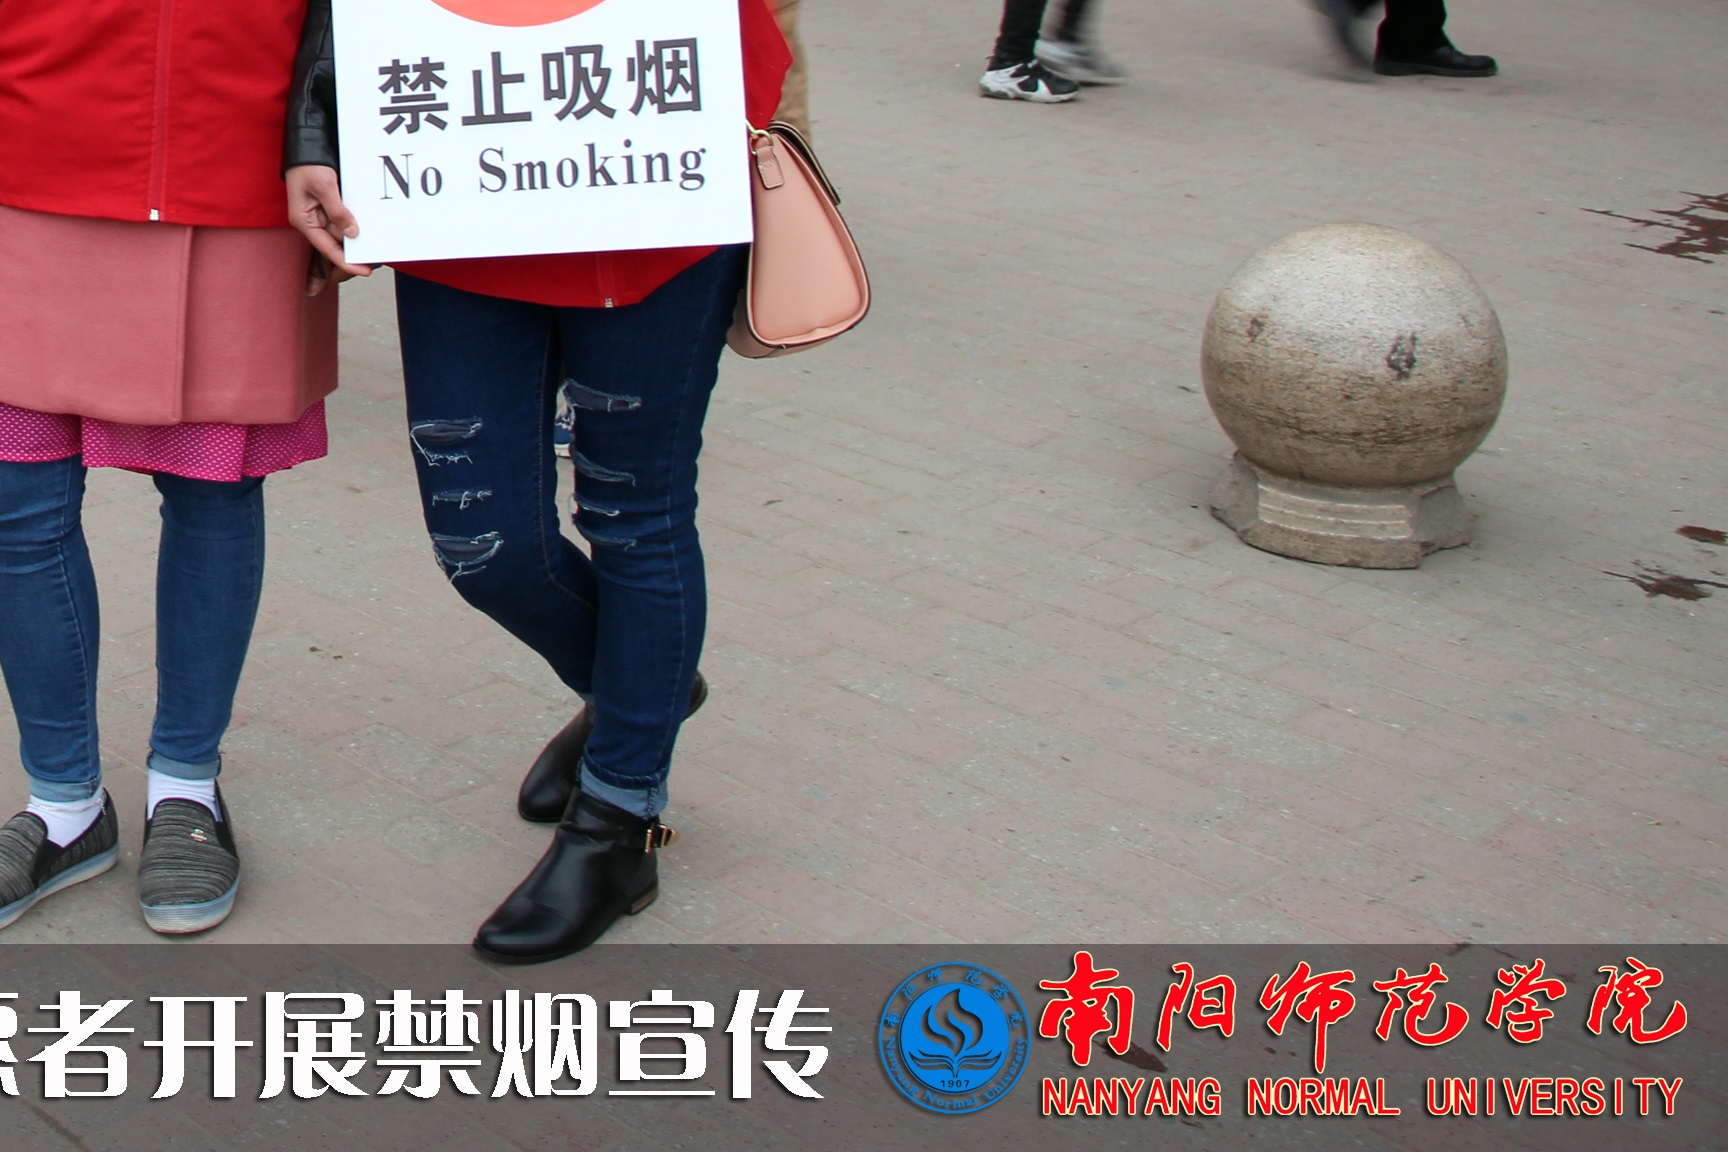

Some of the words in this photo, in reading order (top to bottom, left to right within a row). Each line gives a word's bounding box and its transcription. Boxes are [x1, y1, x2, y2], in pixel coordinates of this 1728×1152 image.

[377, 36, 703, 136] 禁止吸烟
[377, 153, 443, 200] No
[478, 138, 707, 194] Smoking
